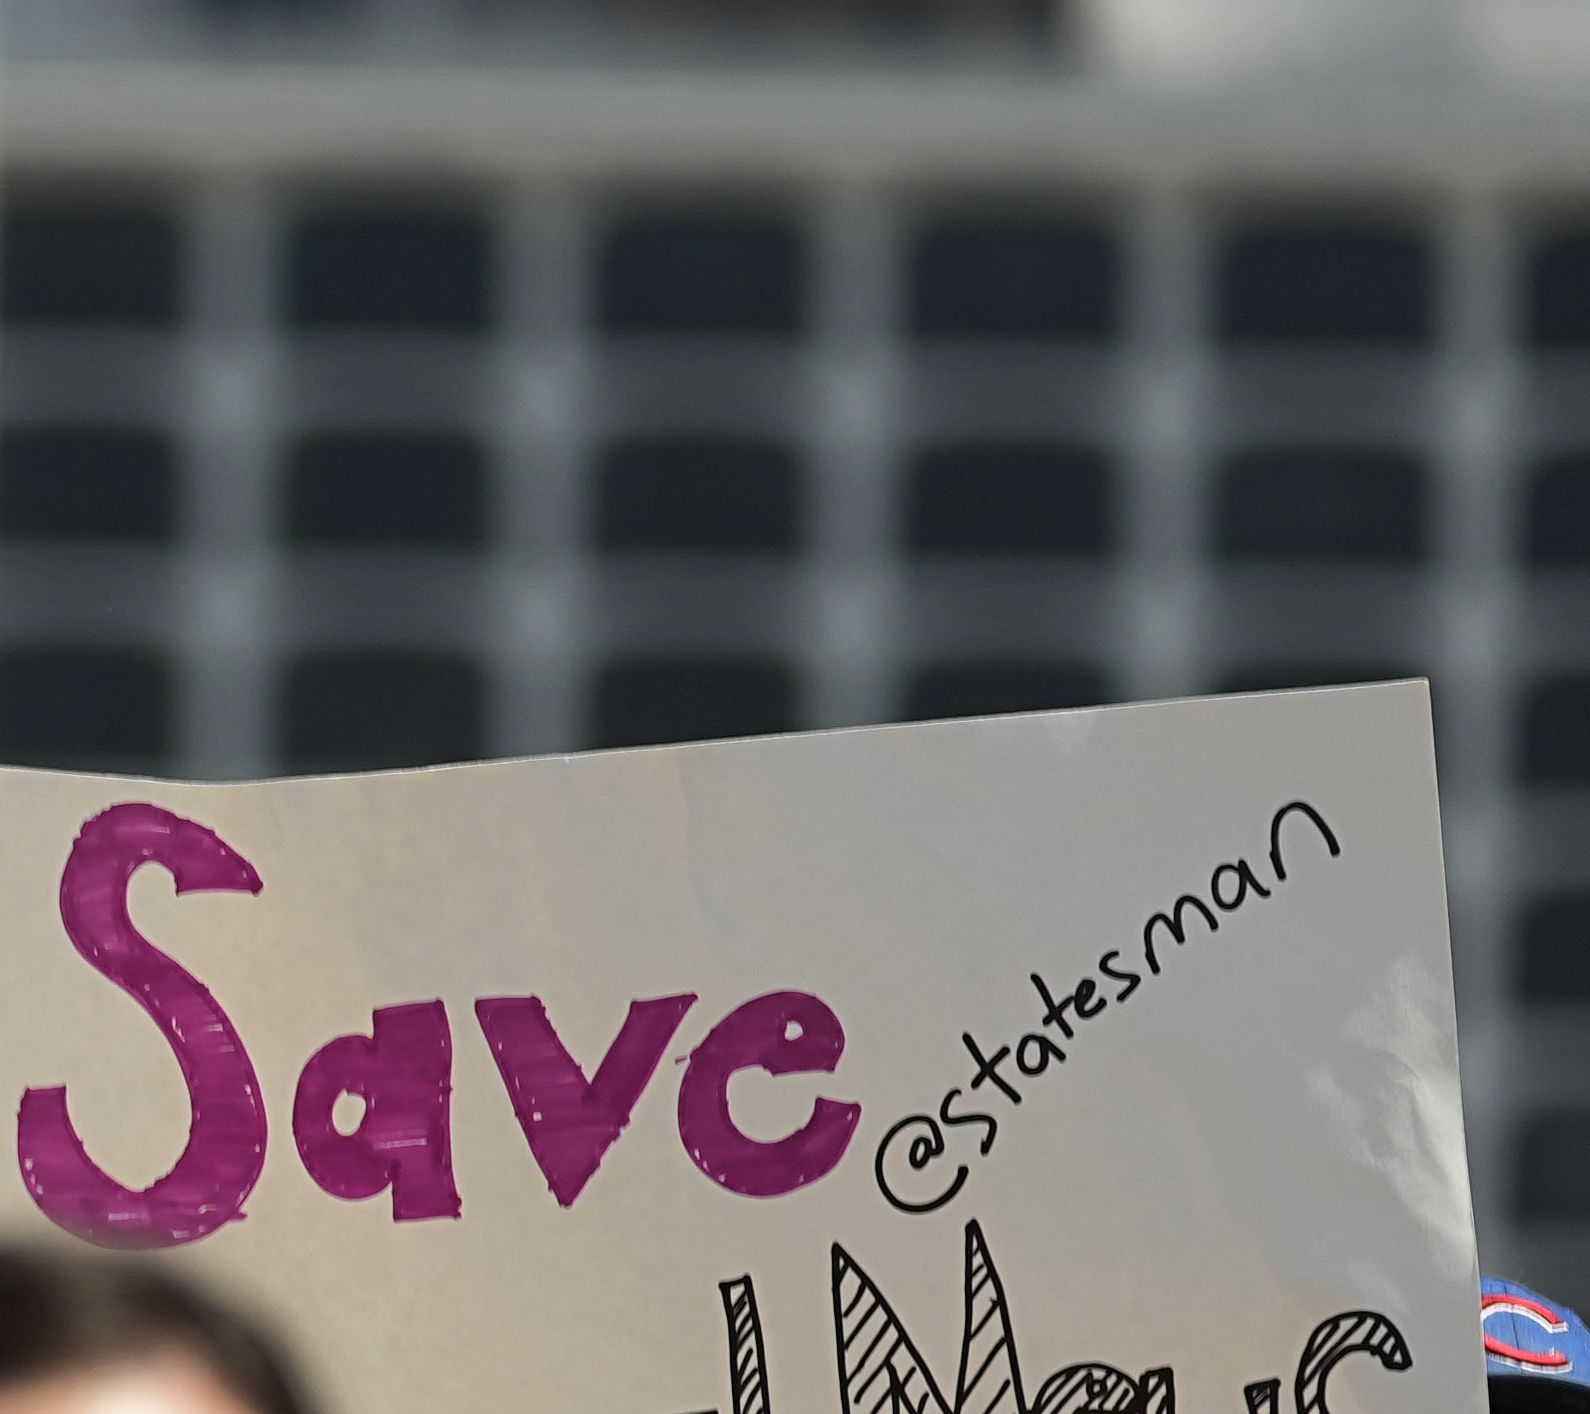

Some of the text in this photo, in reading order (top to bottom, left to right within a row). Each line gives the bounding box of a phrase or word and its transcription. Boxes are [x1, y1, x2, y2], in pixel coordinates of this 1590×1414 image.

[15, 801, 863, 1248] Save
[873, 800, 1341, 1215] @statesman
[1481, 1293, 1573, 1375] C
